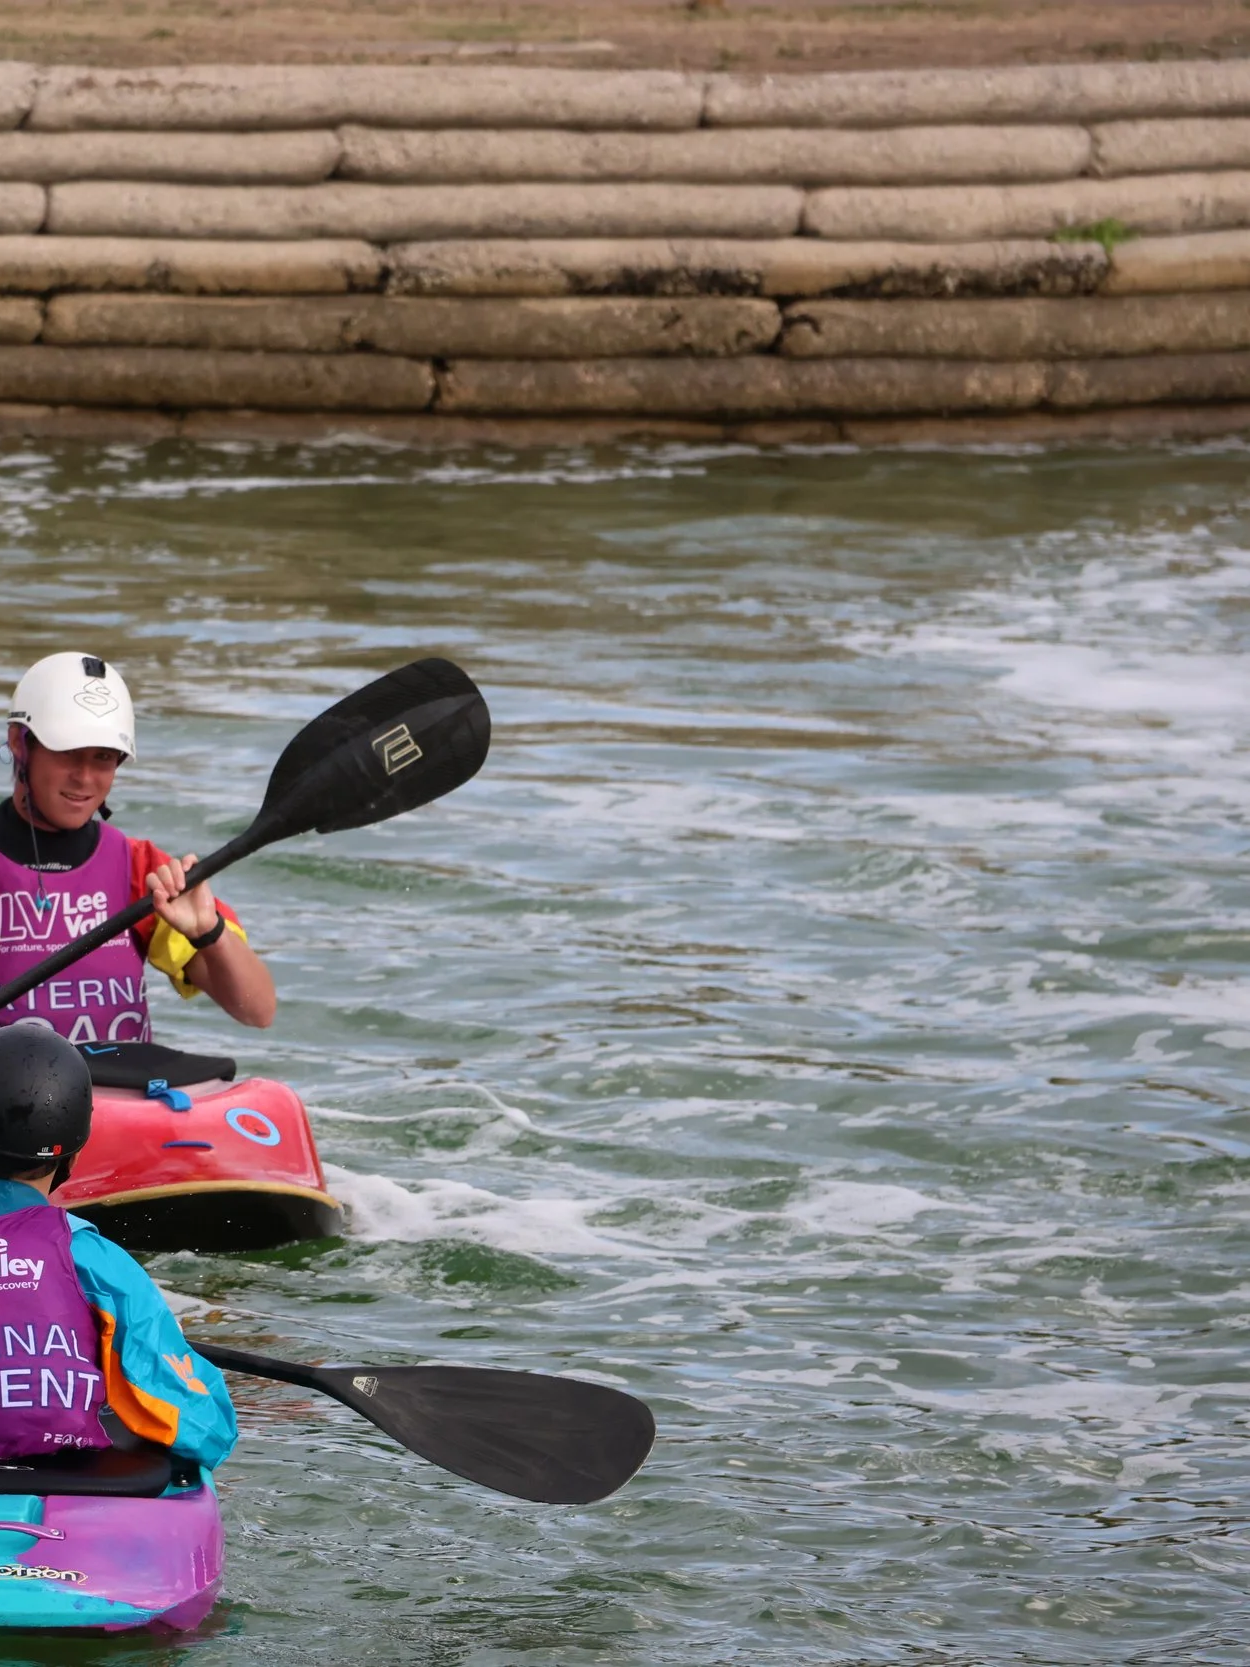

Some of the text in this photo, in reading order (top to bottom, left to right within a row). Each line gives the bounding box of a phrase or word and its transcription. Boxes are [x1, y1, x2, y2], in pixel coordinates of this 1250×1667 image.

[63, 891, 107, 915] Lee
[64, 911, 129, 938] Val
[46, 942, 69, 953] spo
